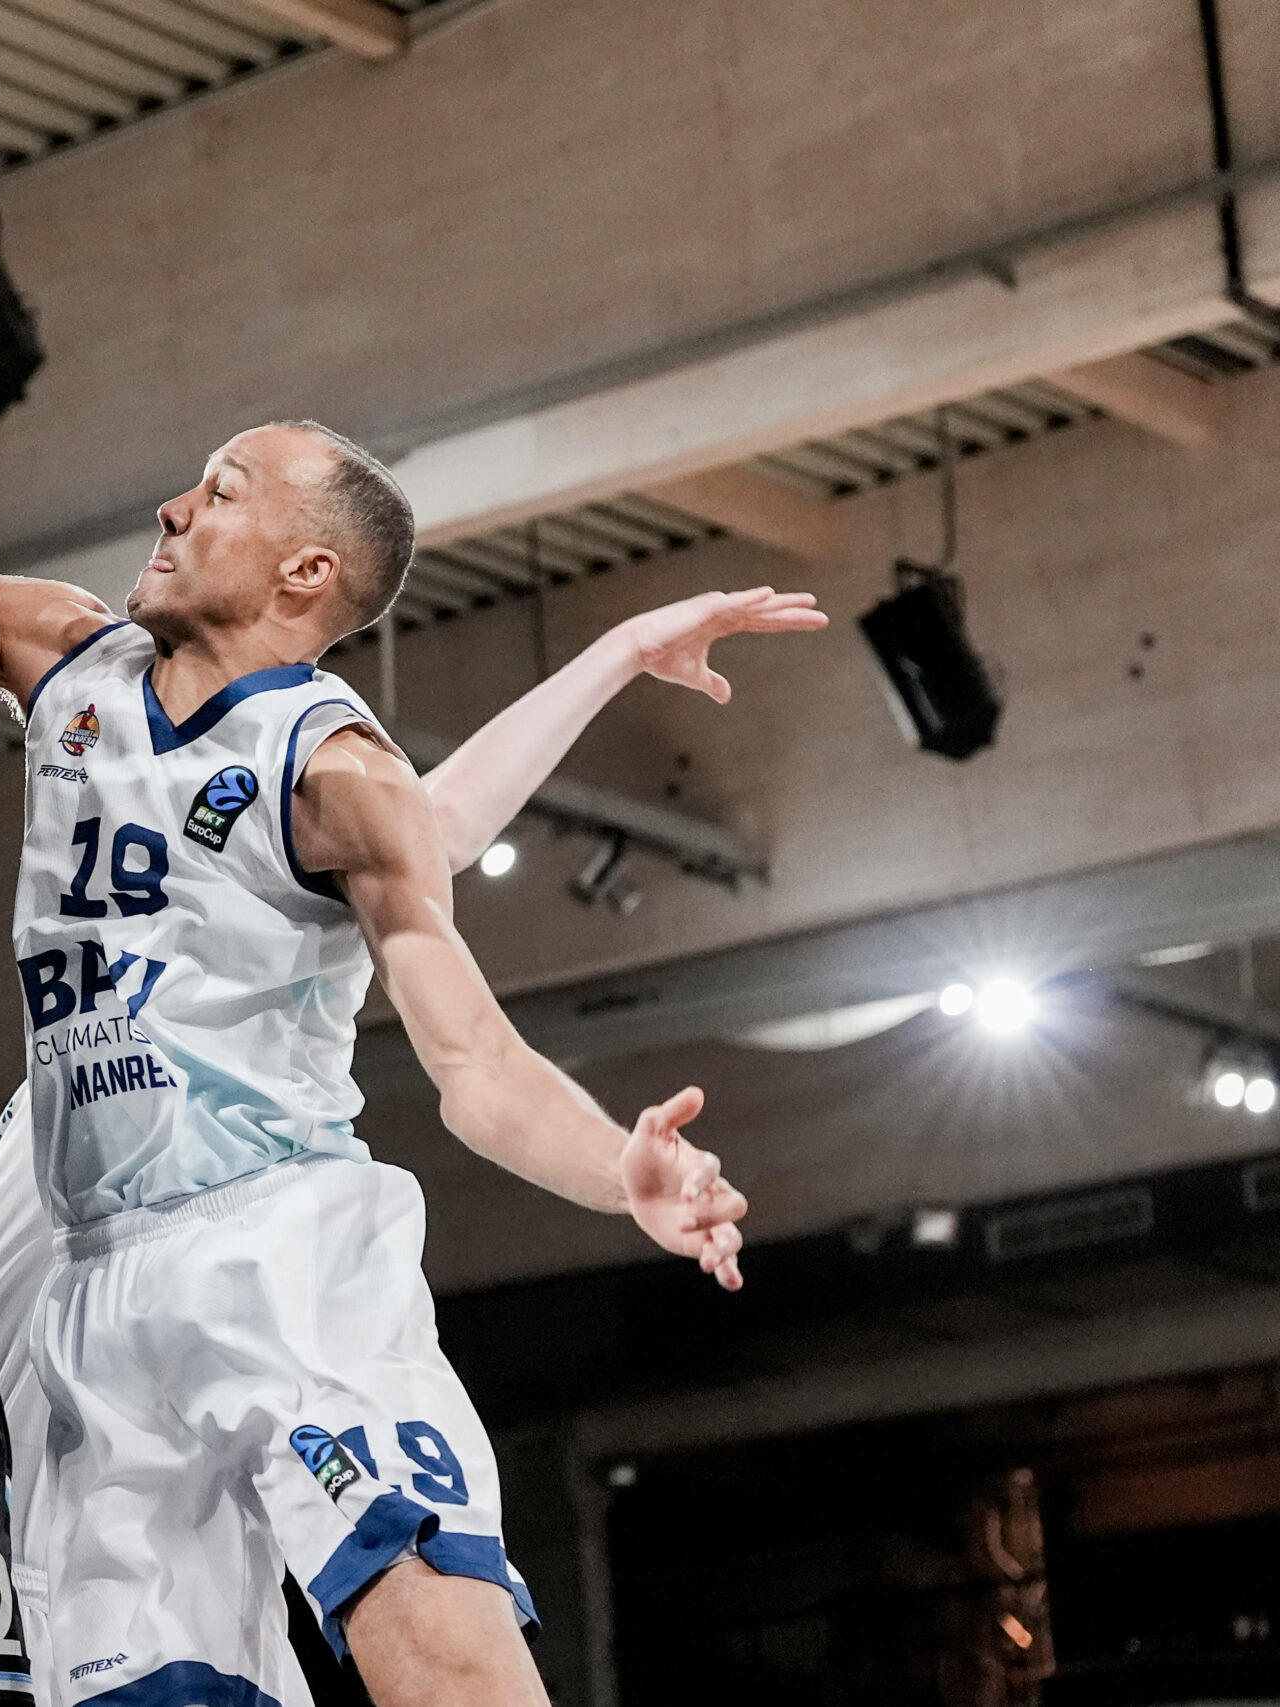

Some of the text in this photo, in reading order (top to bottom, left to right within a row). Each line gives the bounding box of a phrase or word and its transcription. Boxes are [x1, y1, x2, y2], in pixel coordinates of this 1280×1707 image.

[60, 731, 97, 747] MANRESA
[37, 765, 79, 781] PENTEX
[194, 806, 226, 827] BKT
[186, 819, 222, 845] EuroCup
[59, 816, 170, 919] 19
[70, 1053, 177, 1111] MANRE
[316, 1458, 342, 1485] KT
[69, 1657, 114, 1684] PENTEX
